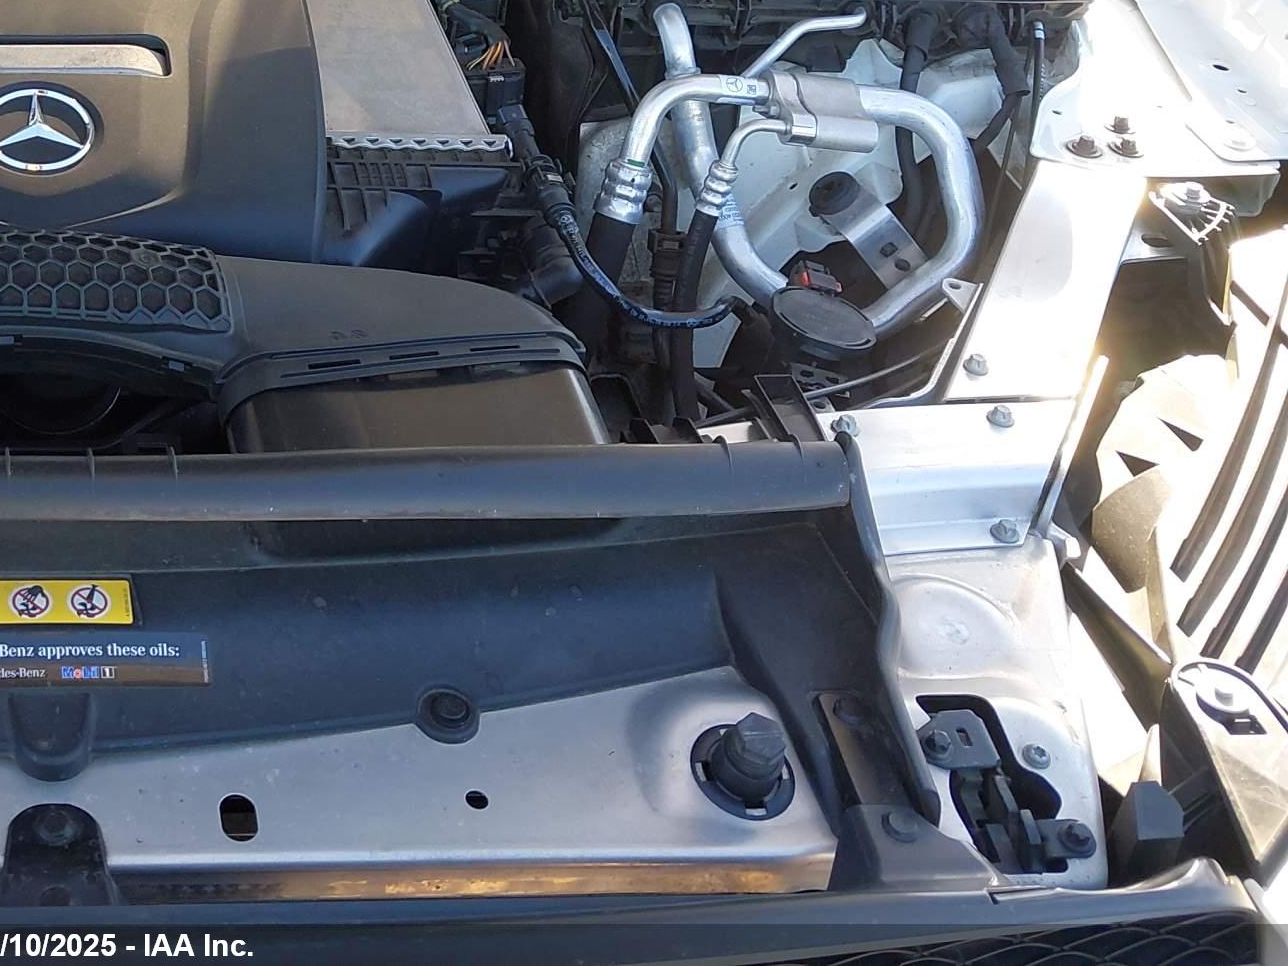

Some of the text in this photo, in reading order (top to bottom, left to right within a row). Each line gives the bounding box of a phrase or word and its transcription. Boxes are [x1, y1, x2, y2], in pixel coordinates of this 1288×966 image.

[37, 645, 104, 660] approves
[106, 642, 146, 657] these
[149, 642, 180, 657] oils:
[61, 665, 100, 679] Mobil
